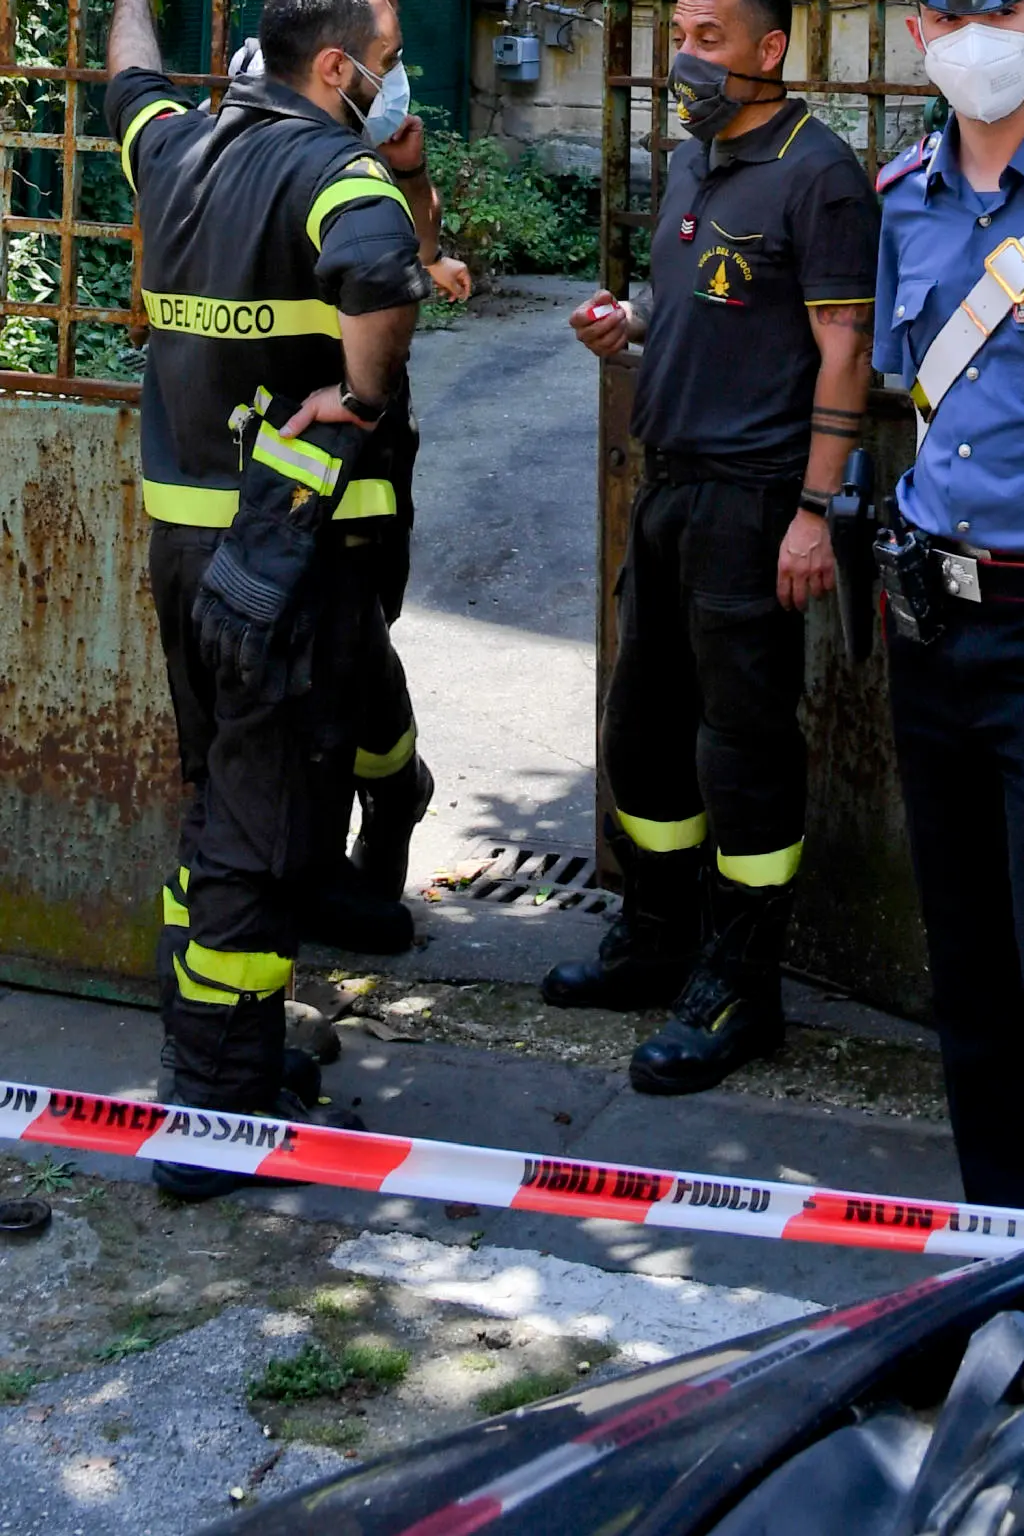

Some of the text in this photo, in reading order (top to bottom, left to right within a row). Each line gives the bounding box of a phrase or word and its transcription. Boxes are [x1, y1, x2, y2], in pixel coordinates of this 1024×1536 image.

[732, 252, 752, 281] FUOCO
[160, 298, 191, 328] DEL
[194, 301, 275, 335] FUOCO
[49, 1093, 299, 1152] OLTREPASSARE
[521, 1159, 607, 1195] VIGILI
[612, 1170, 662, 1203] DEL
[672, 1179, 771, 1213] FUOCO
[844, 1199, 934, 1229] NON
